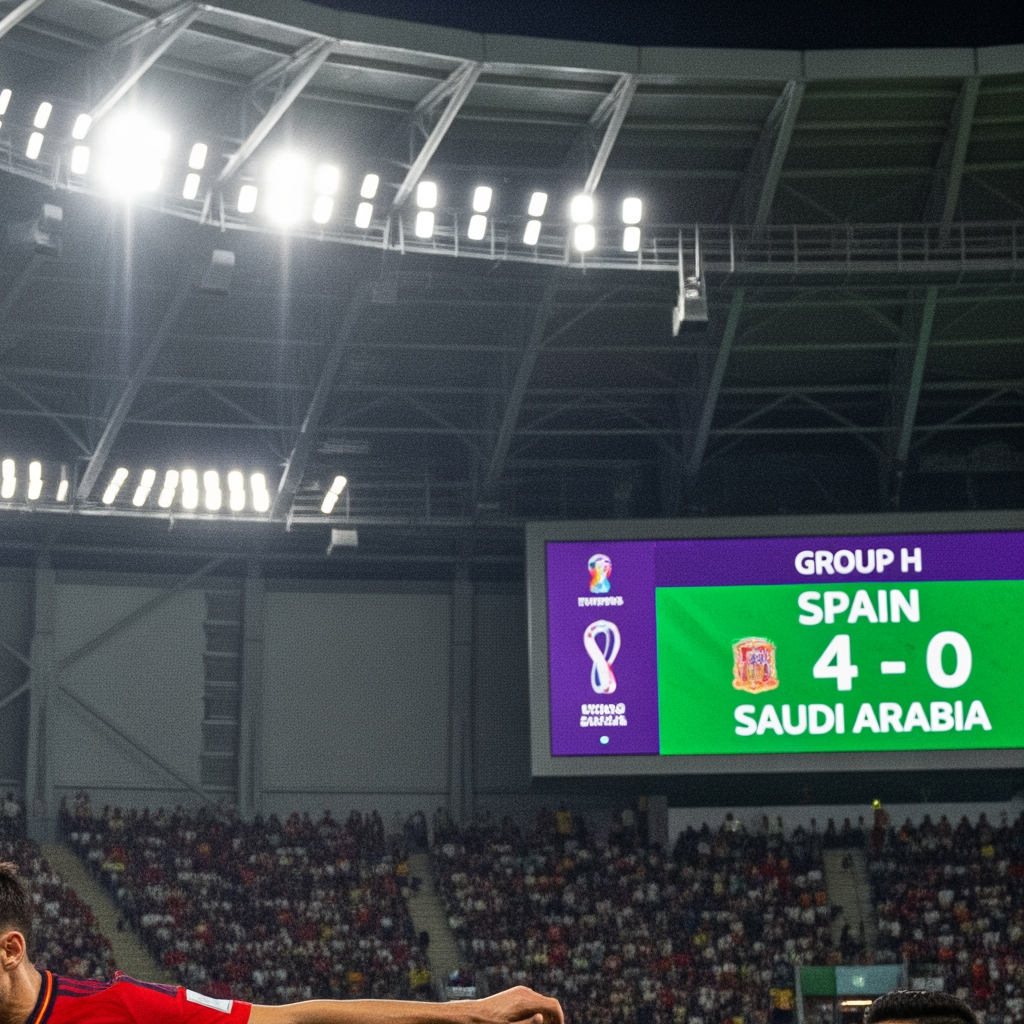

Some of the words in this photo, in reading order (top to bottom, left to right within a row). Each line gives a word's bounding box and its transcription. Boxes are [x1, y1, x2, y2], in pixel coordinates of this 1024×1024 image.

[794, 549, 894, 575] GROUP
[901, 548, 922, 573] H
[797, 589, 920, 626] SPAIN
[812, 634, 858, 692] 4
[925, 630, 972, 689] 0
[734, 703, 845, 737] SAUDI
[852, 700, 992, 734] ARABIA
